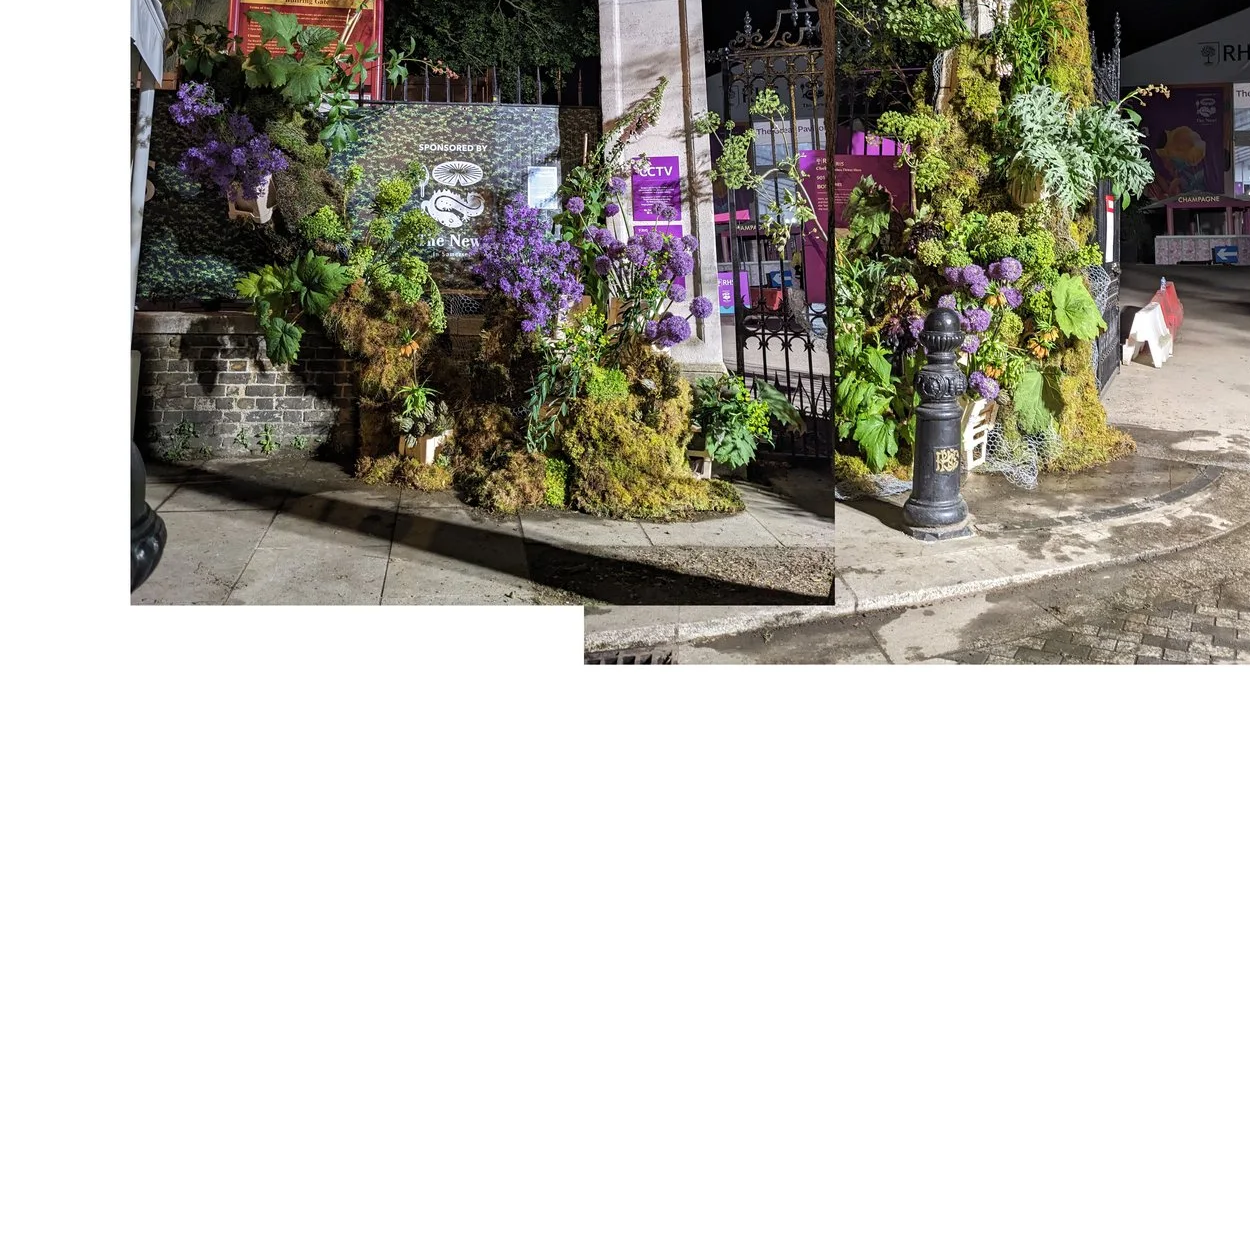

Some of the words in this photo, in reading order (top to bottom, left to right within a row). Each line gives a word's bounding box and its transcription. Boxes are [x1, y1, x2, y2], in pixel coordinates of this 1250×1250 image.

[419, 144, 474, 152] SPONSORED
[476, 144, 488, 152] BY
[639, 166, 673, 177] CCTV
[450, 233, 481, 248] New
